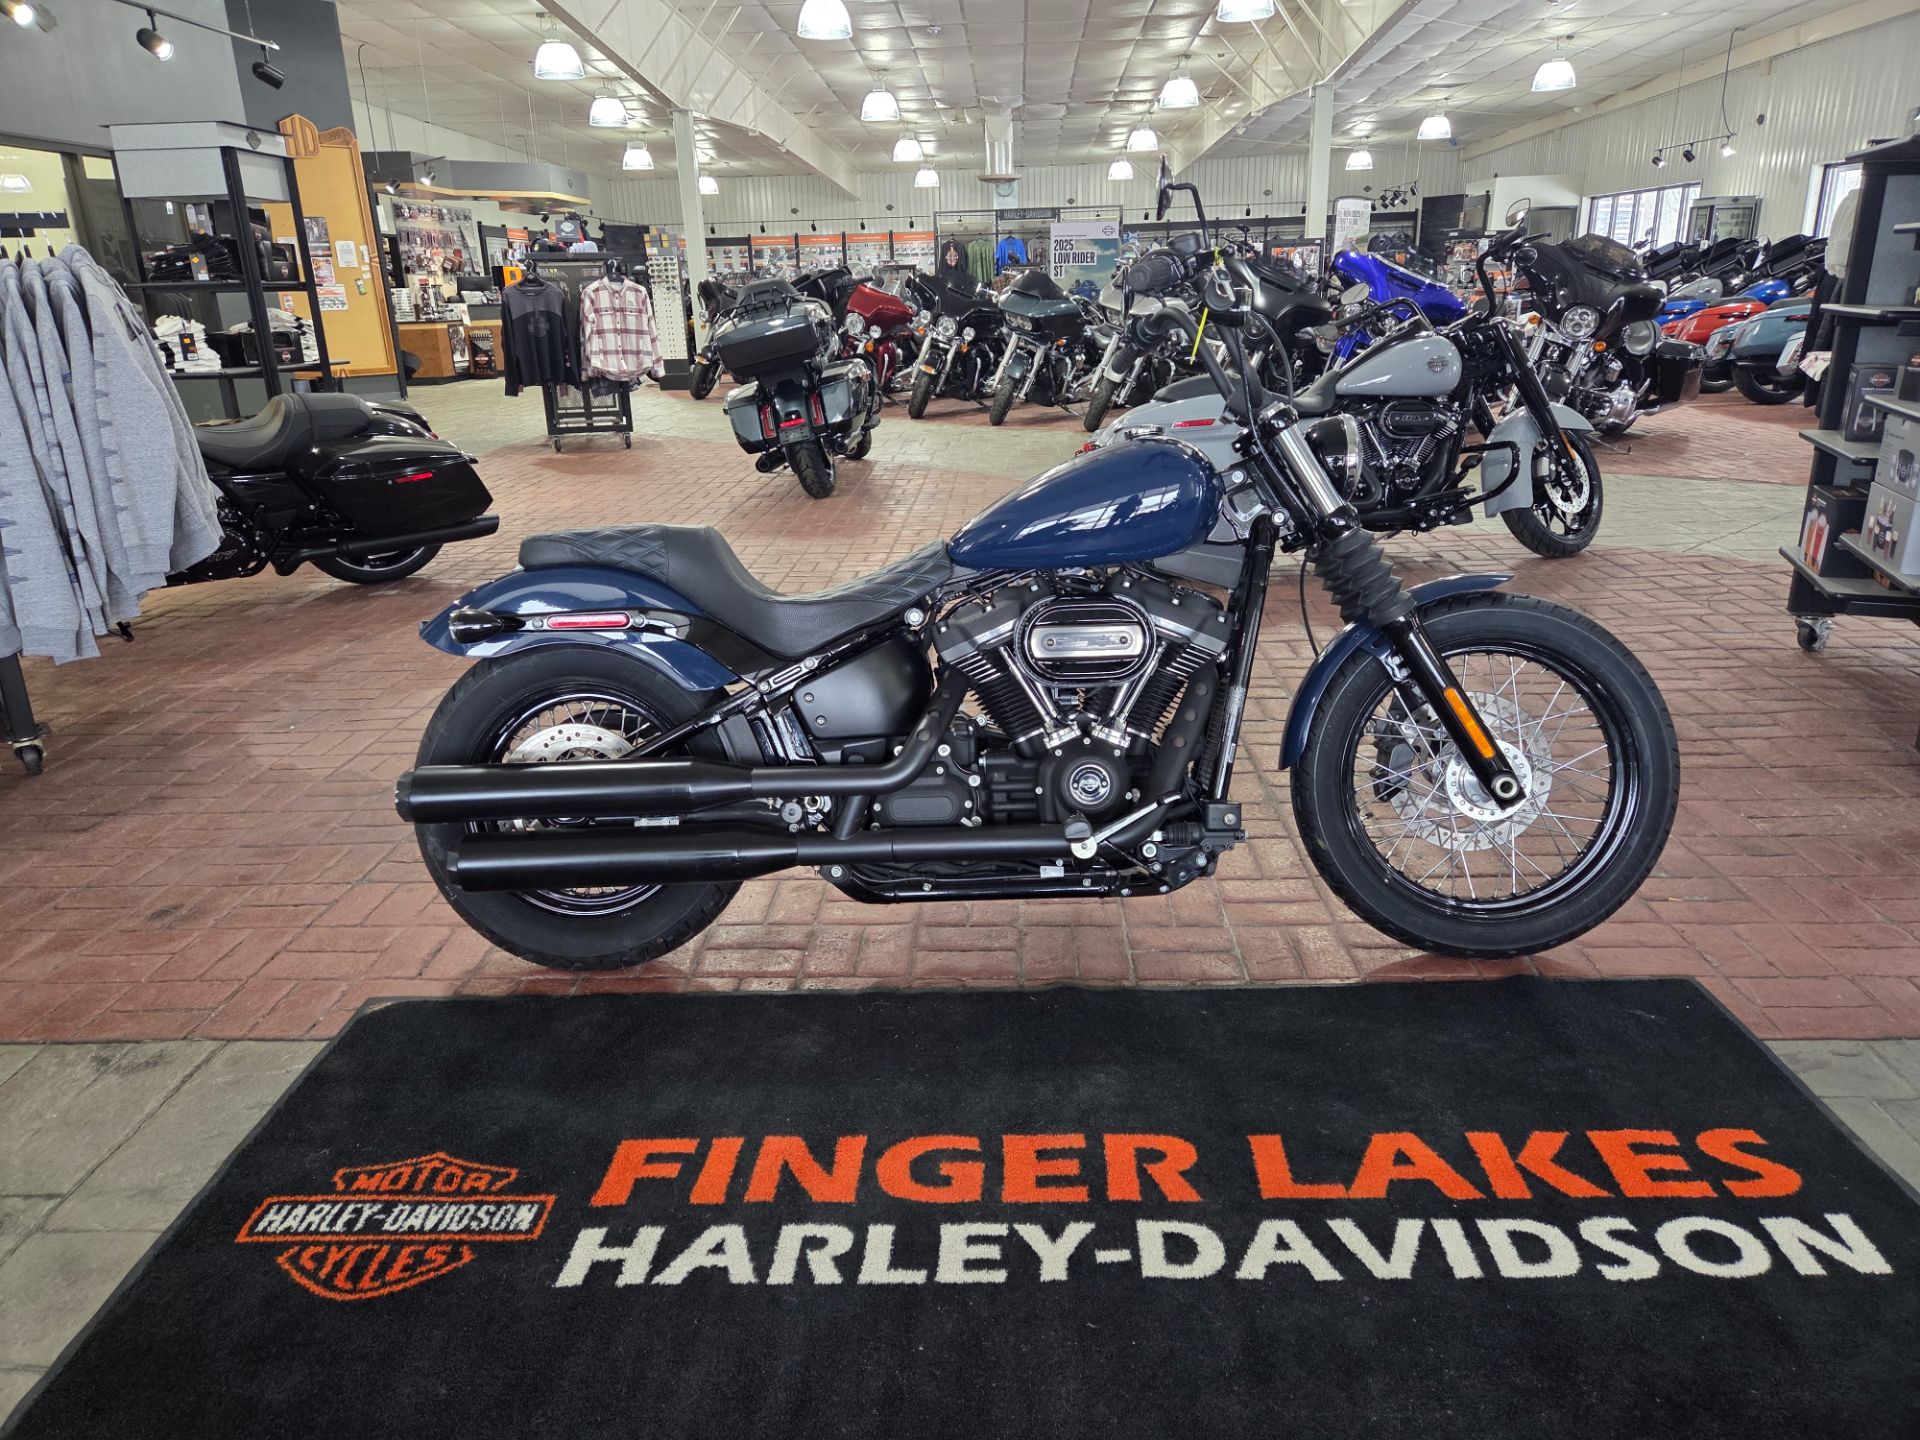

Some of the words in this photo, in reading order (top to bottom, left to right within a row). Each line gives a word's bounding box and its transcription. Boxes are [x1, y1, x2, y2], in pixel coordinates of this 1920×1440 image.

[1003, 210, 1052, 219] HARLEY-DAVIDSON
[1054, 240, 1074, 251] 2025
[1054, 252, 1070, 264] LOW
[1072, 252, 1095, 263] RIDER
[1054, 266, 1064, 277] ST
[351, 1160, 494, 1193] MOTOR
[590, 1133, 1201, 1206] FINGER
[1247, 1128, 1802, 1199] LAKES
[254, 1203, 540, 1233] HARLEY-DAVIDSON
[555, 1213, 1893, 1288] HARLEY-DAVIDSON
[299, 1245, 453, 1290] CYCLES
